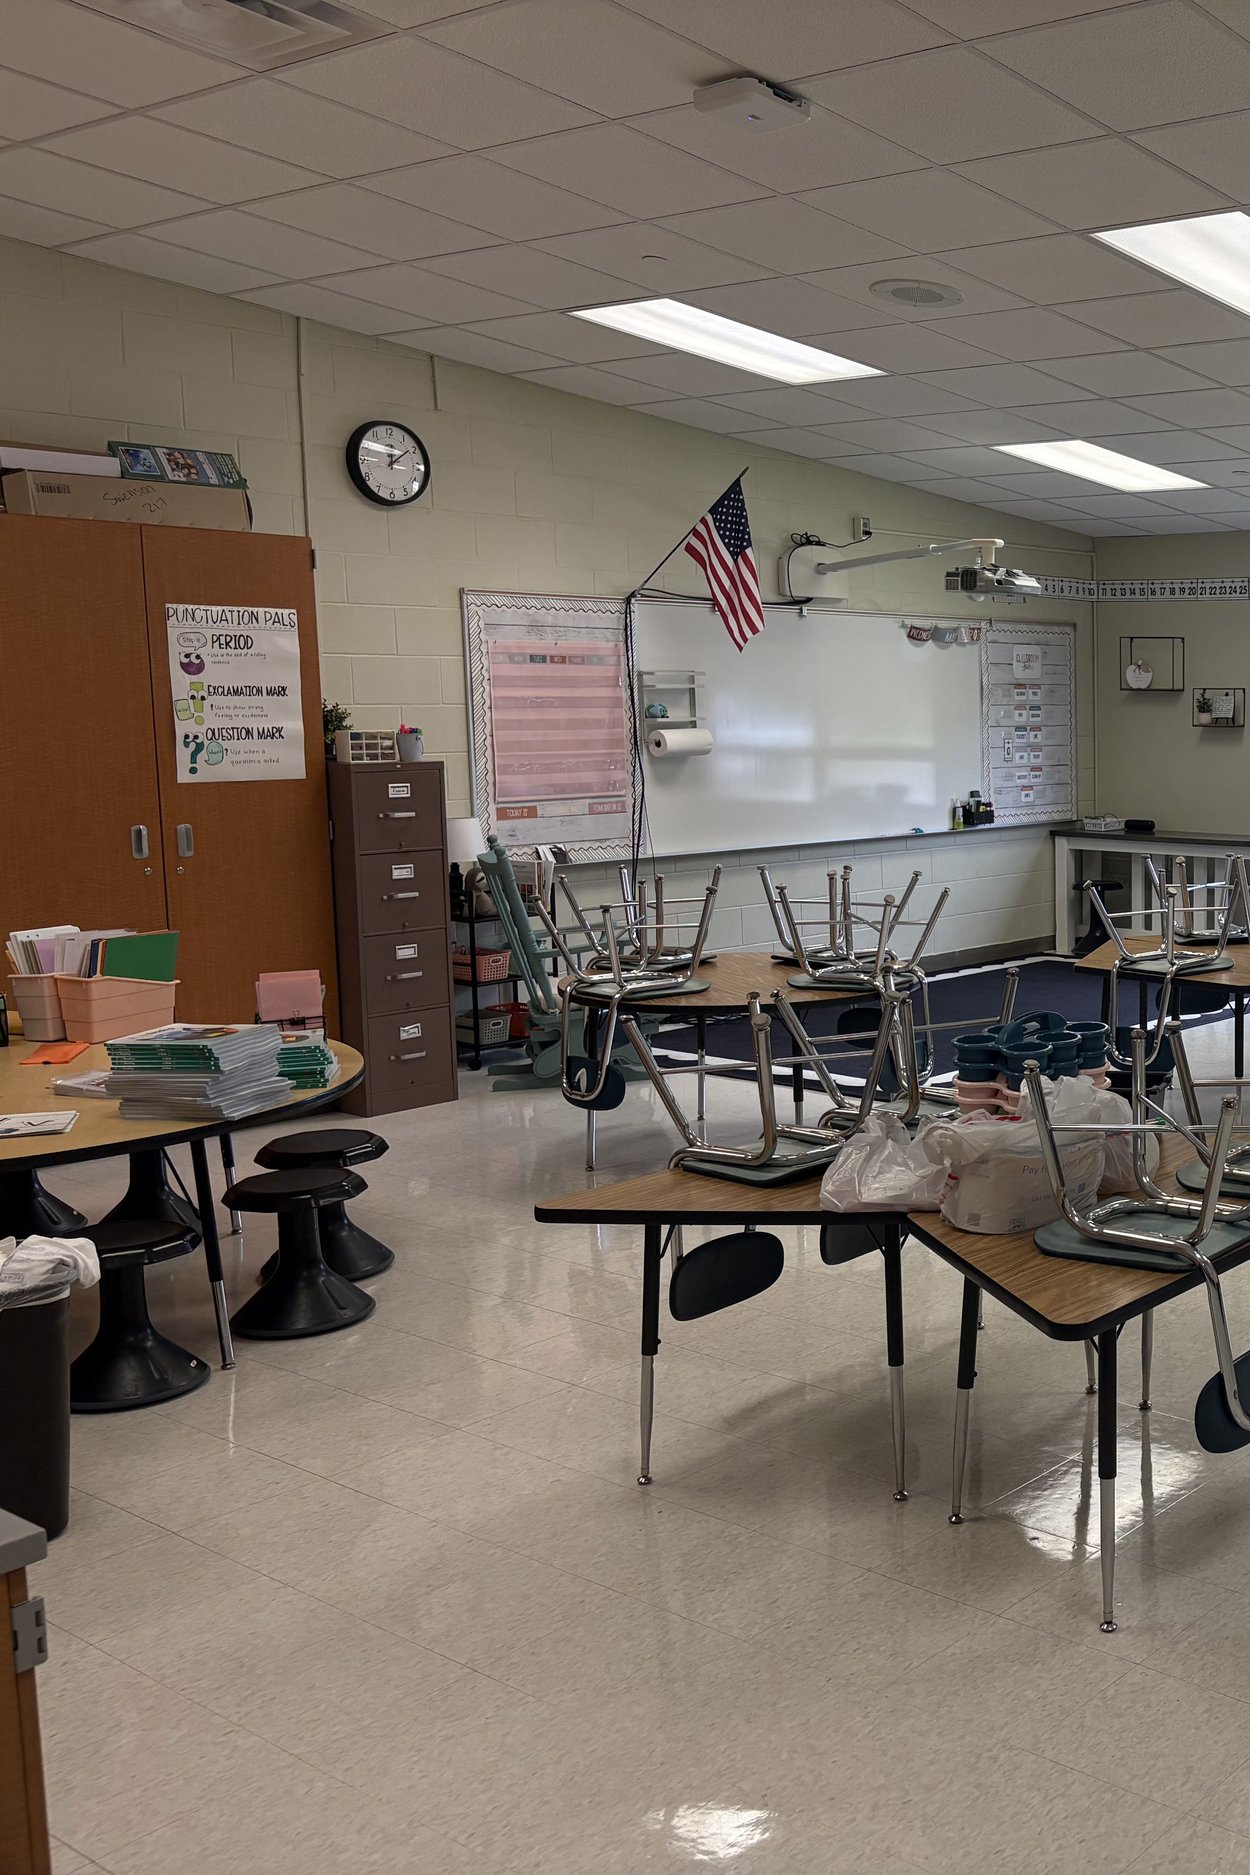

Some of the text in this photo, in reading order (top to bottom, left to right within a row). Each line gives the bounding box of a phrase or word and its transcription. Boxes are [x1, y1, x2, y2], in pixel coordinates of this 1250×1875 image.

[372, 429, 378, 439] 11
[385, 427, 394, 437] 12
[412, 446, 417, 454] 2
[364, 472, 370, 481] 8
[376, 485, 381, 493] 7
[389, 490, 395, 499] 6
[403, 488, 408, 496] 5
[142, 497, 168, 513] 217
[1087, 587, 1095, 597] 10
[1101, 587, 1107, 597] 11
[1110, 587, 1117, 597] 12
[1119, 587, 1127, 597] 13
[1129, 587, 1136, 596] 14
[1139, 587, 1146, 596] 15
[1149, 587, 1157, 596] 16
[1159, 587, 1166, 596] 17
[1169, 587, 1176, 596] 18
[1179, 587, 1186, 596] 19
[1187, 586, 1197, 596] 20
[1199, 586, 1207, 596] 21
[1208, 586, 1217, 595] 22
[1218, 586, 1227, 595] 23
[1228, 585, 1237, 595] 24
[1238, 585, 1247, 595] 25
[166, 606, 297, 628] PUNCTUATION PALS
[211, 633, 254, 650] PERIOD
[207, 684, 288, 697] EXCLAMATION MARK
[205, 726, 285, 741] QUESTION MARK
[1022, 1164, 1039, 1176] Pay
